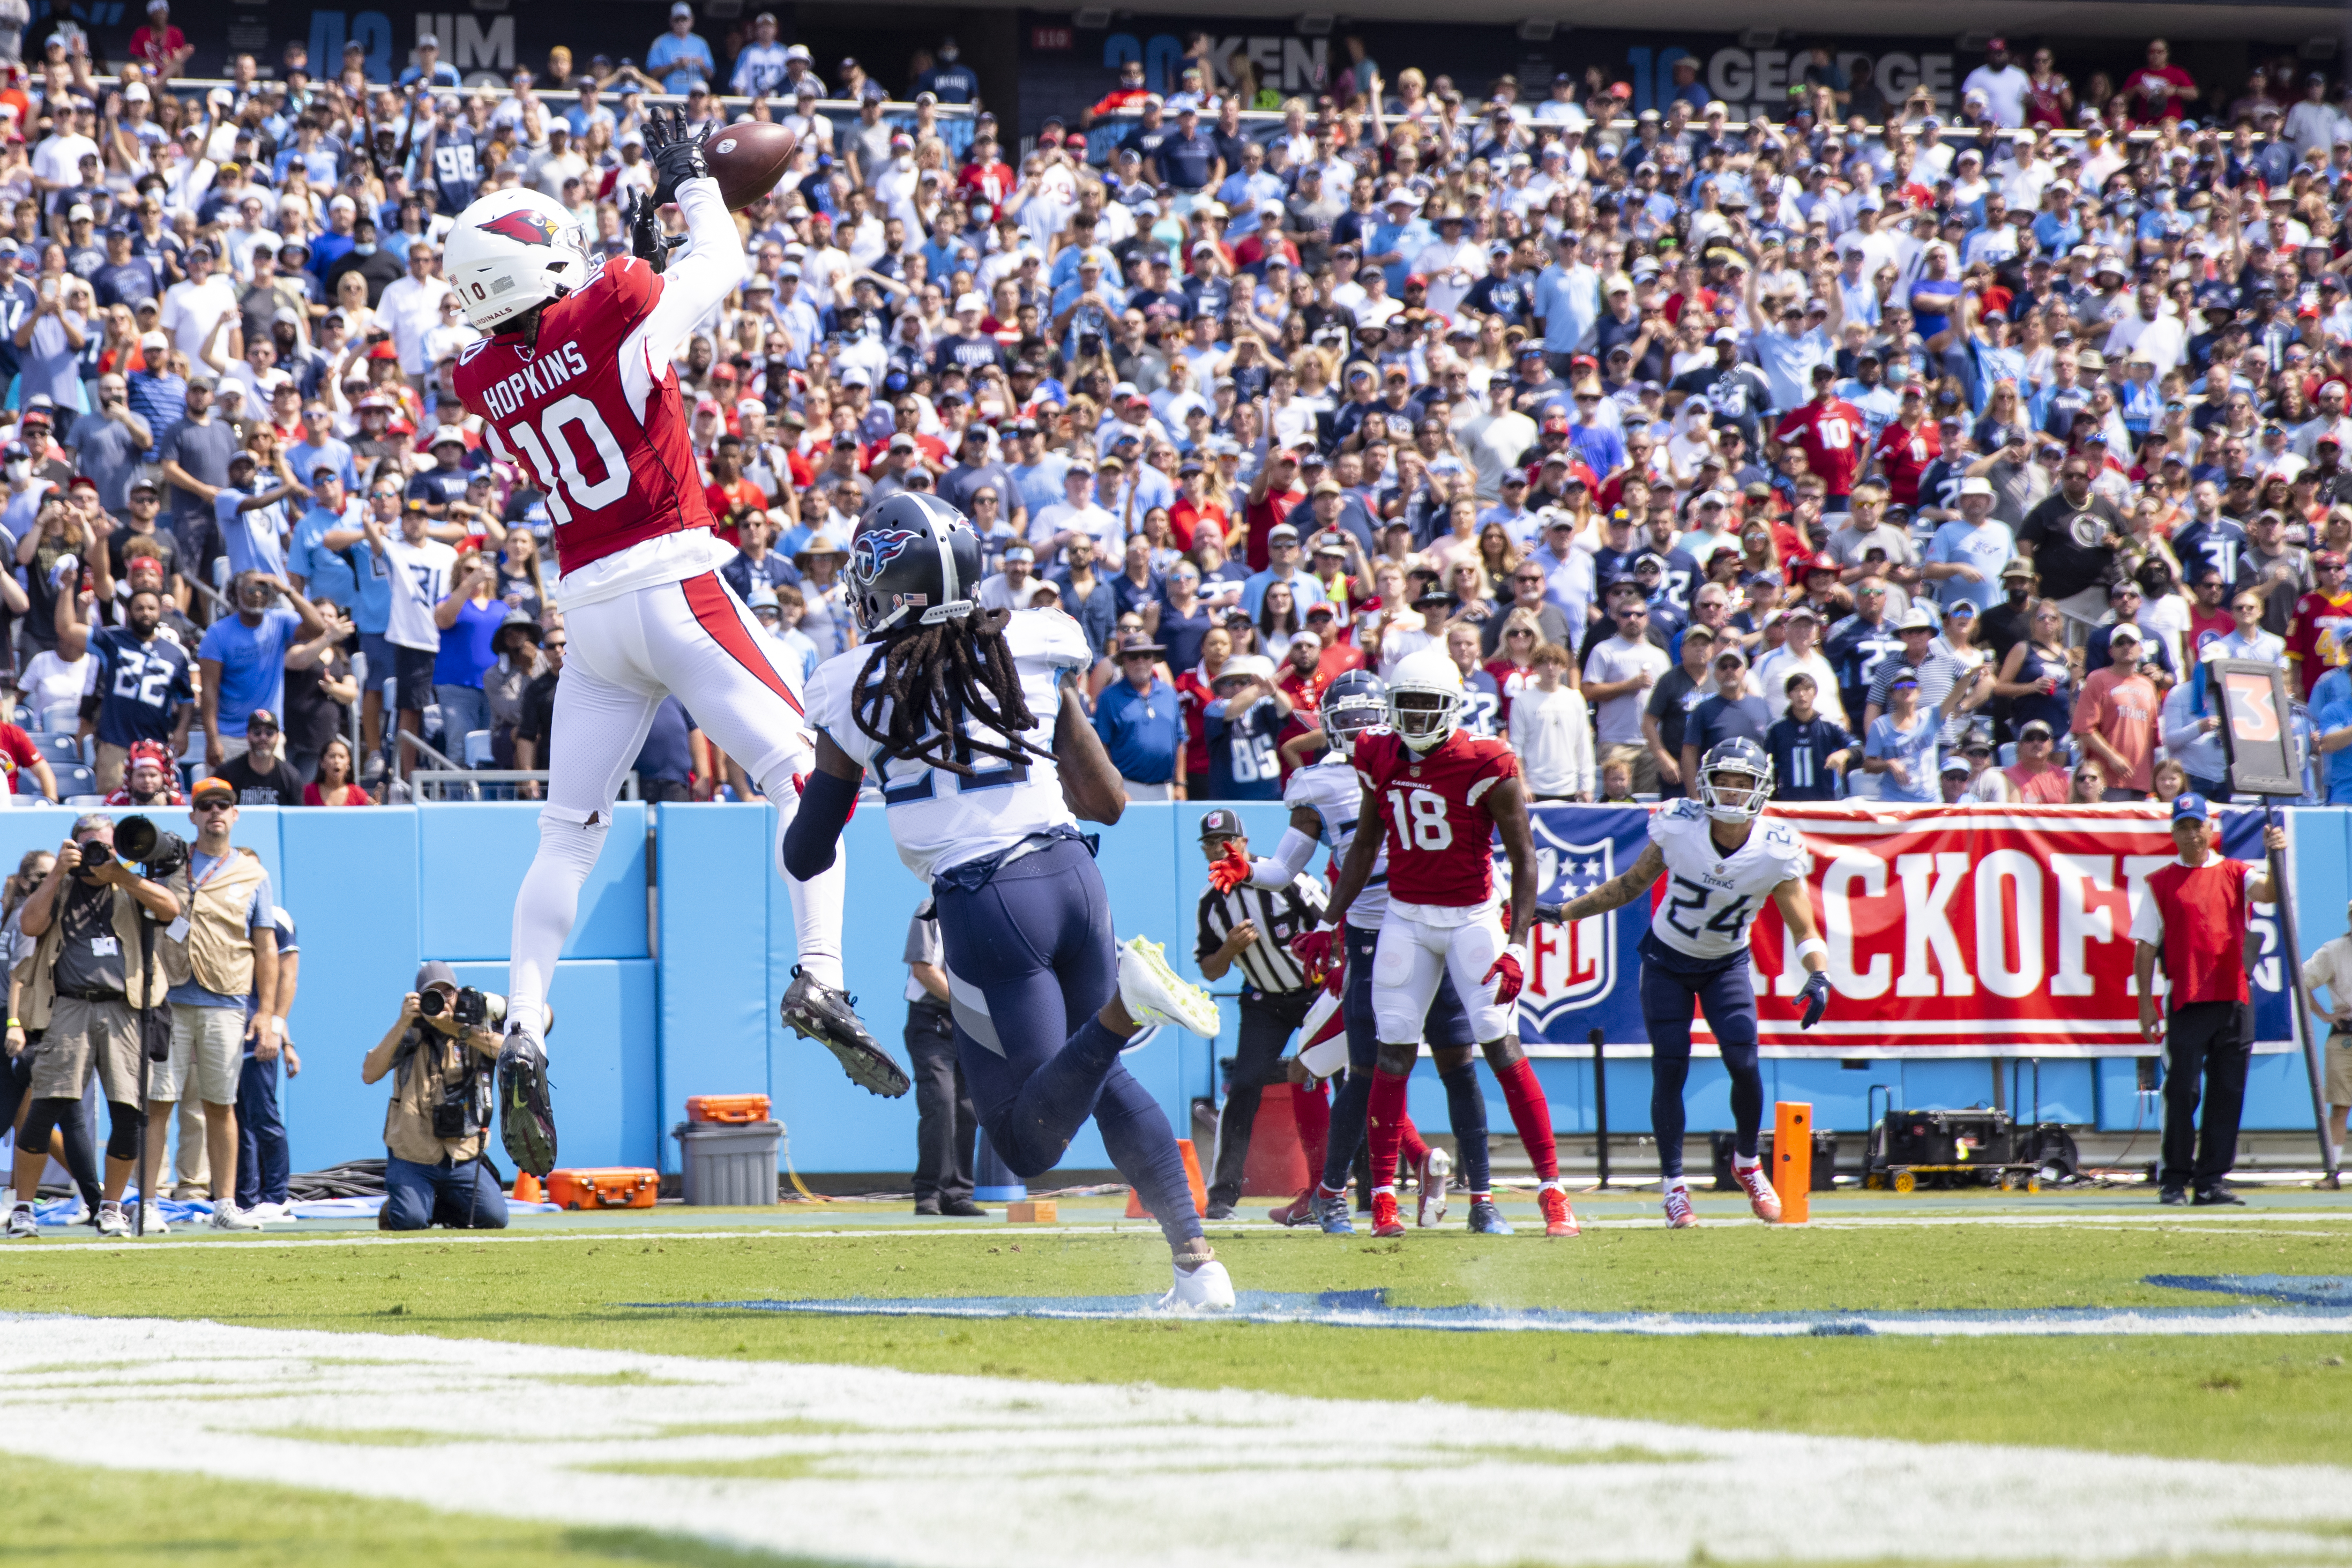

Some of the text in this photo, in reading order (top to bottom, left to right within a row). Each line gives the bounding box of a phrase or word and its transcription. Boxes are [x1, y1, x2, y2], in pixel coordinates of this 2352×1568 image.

[435, 145, 474, 182] 98
[473, 307, 513, 326] CARDINALS
[482, 340, 588, 421] HOPKINS
[1818, 418, 1851, 449] 10
[509, 393, 632, 526] 10
[2197, 540, 2236, 585] 31
[113, 646, 176, 707] 22
[2117, 705, 2148, 722] TITANS
[2226, 674, 2280, 741] 3
[1232, 736, 1281, 783] 85
[1791, 746, 1813, 787] 11
[1392, 779, 1432, 789] CARDINALS
[1386, 789, 1453, 851] 18
[1666, 873, 1753, 941] 24
[1529, 919, 1596, 997] FL
